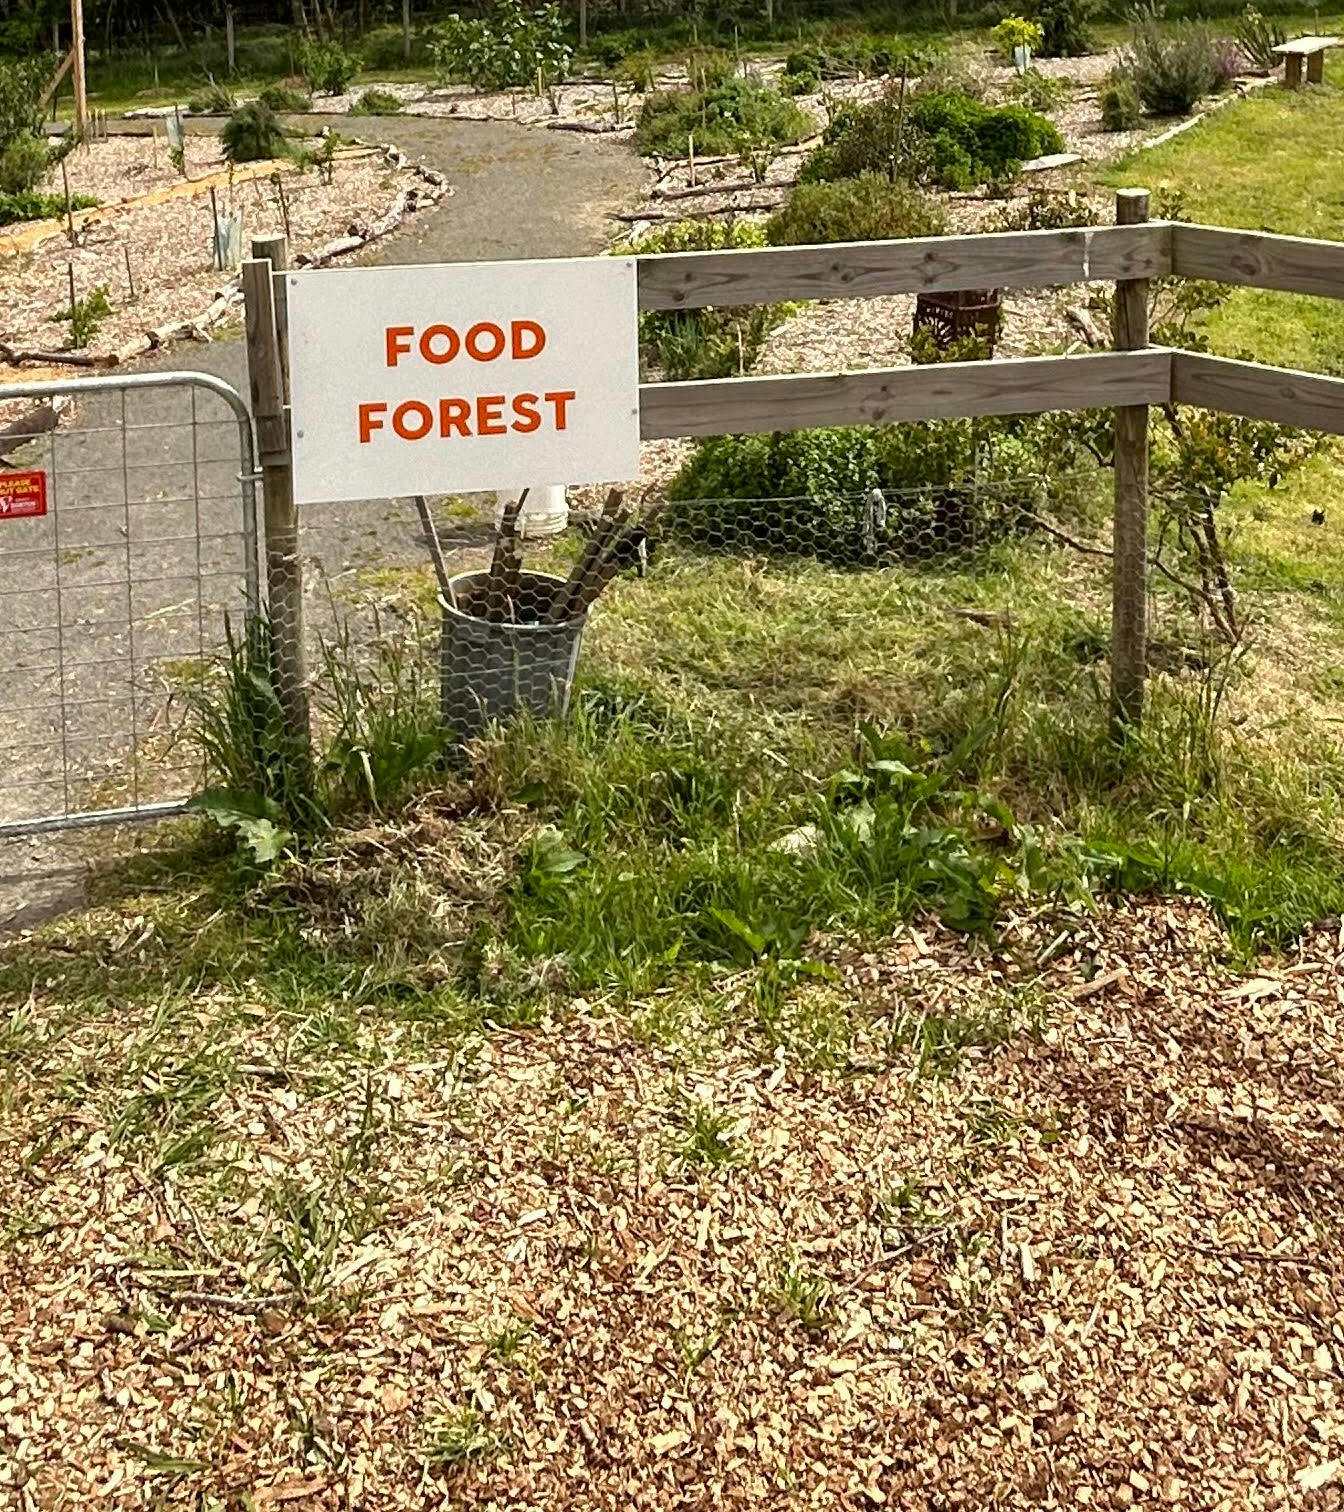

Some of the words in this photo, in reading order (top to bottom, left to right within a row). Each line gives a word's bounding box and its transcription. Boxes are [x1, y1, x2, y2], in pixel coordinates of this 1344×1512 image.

[386, 320, 546, 367] FOOD
[358, 390, 576, 443] FOREST
[15, 485, 39, 494] GATE
